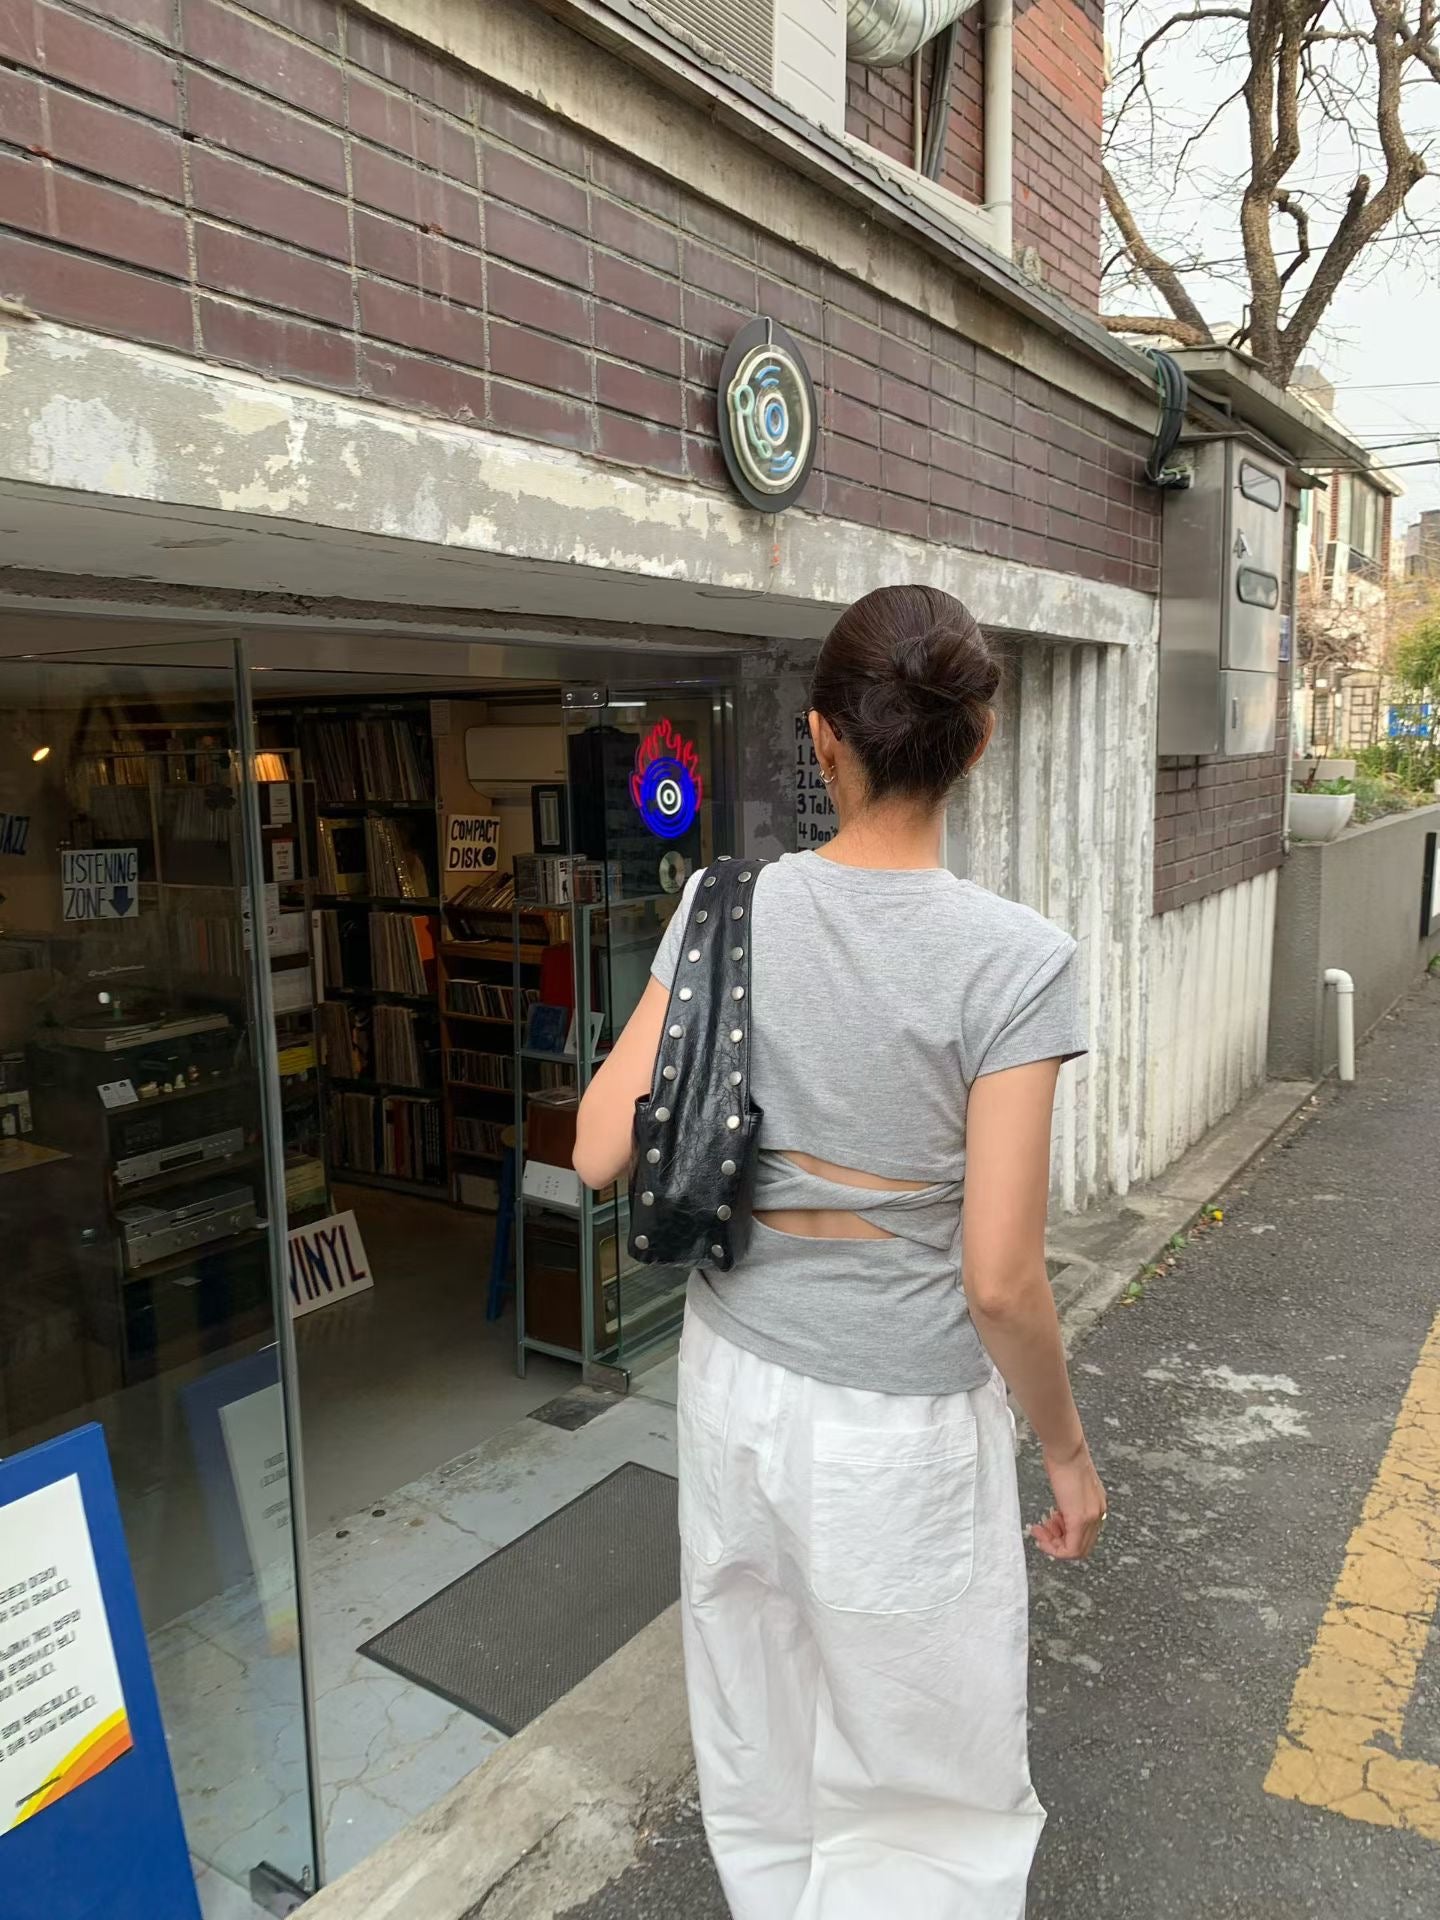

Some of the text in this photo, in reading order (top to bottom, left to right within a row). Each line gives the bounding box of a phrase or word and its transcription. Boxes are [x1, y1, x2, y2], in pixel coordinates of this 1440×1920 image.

[795, 717, 813, 740] PA
[796, 744, 805, 766] 1
[796, 769, 807, 790] 2
[796, 793, 836, 816] 3 Talk
[451, 818, 500, 844] COMPACT
[798, 821, 808, 840] 4
[63, 852, 138, 885] LISTENING
[449, 846, 482, 869] DISK
[64, 886, 108, 920] ZONE
